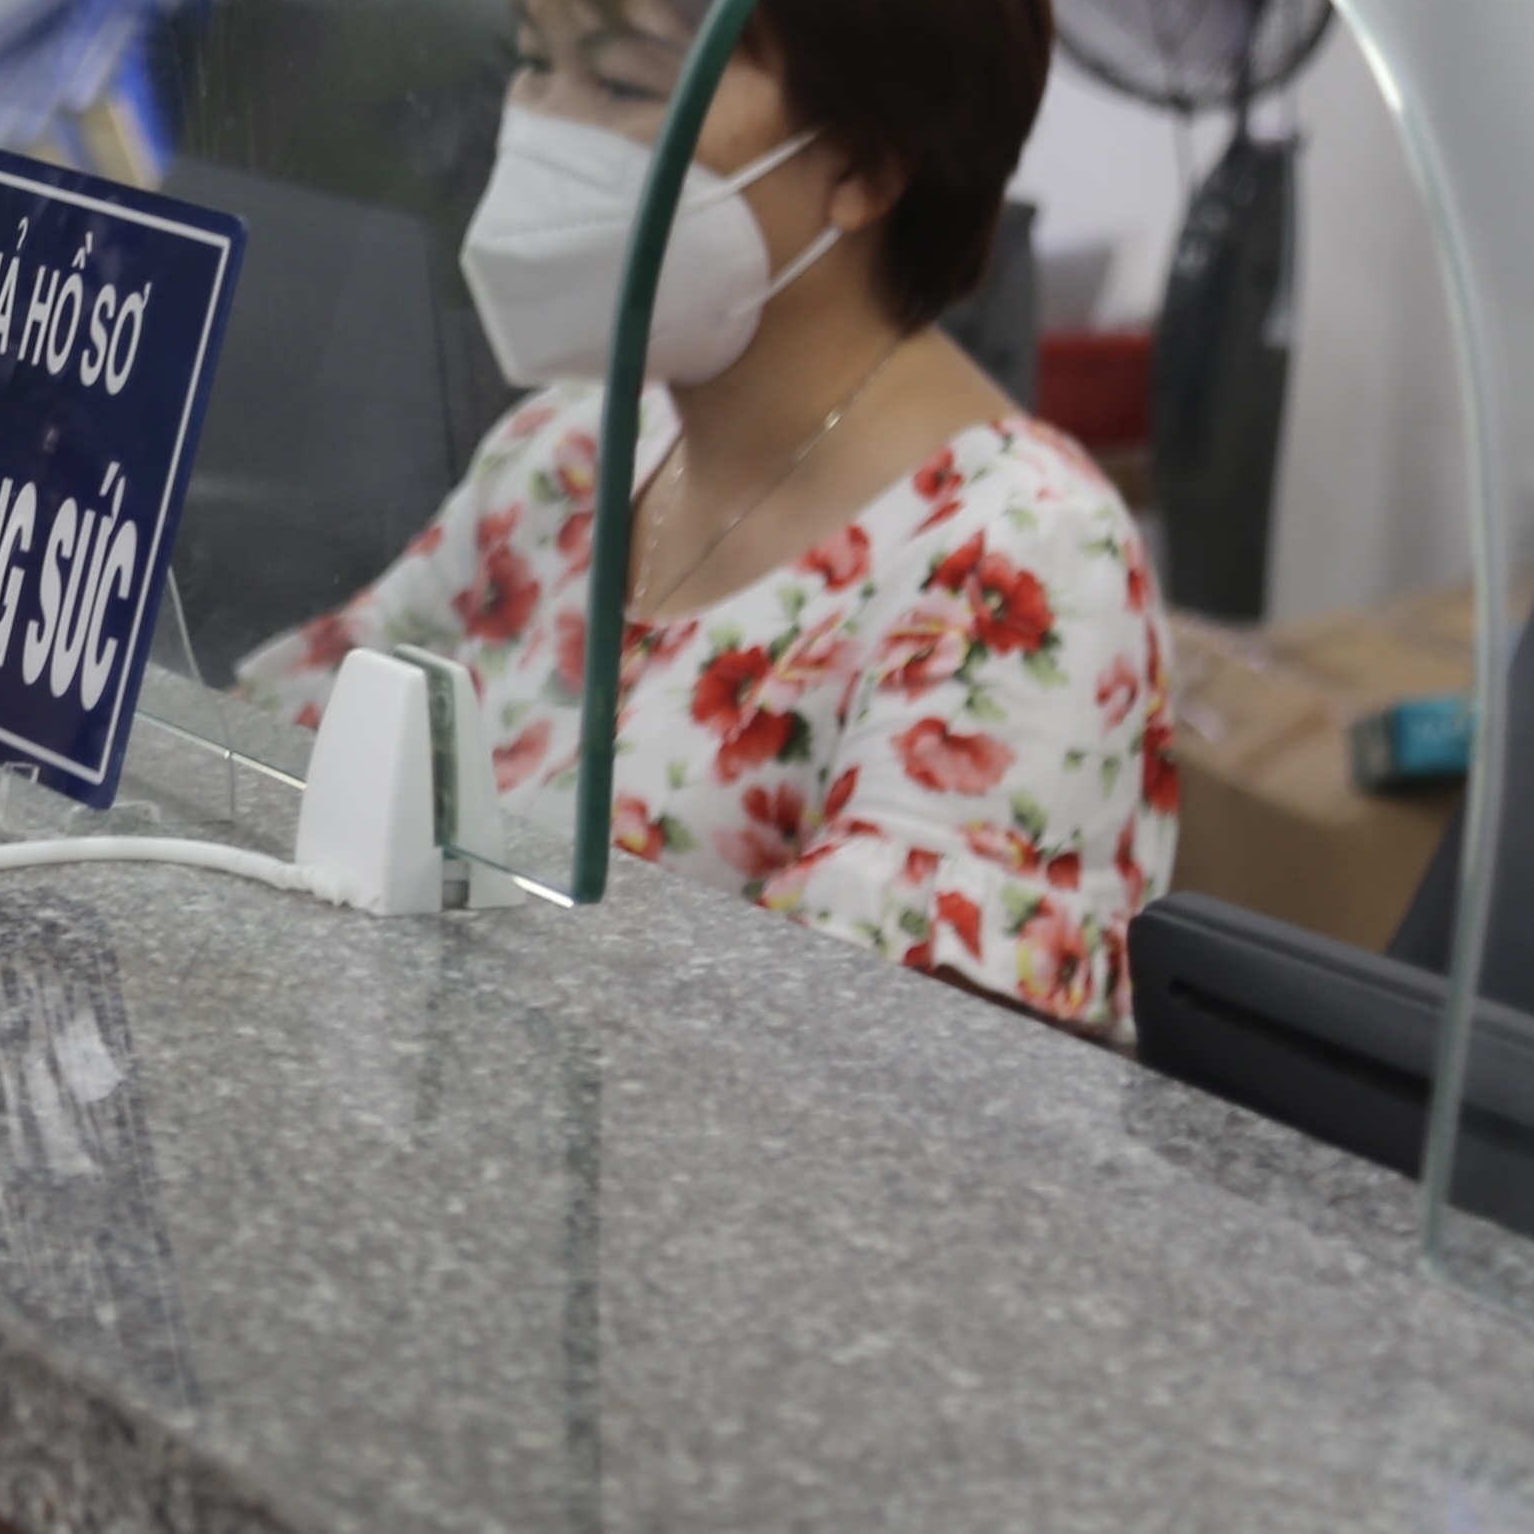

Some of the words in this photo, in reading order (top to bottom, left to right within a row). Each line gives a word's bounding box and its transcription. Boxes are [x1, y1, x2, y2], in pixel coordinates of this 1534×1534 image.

[18, 233, 96, 377] HỒ
[79, 280, 151, 397] SƠ
[20, 461, 137, 712] SỨC
